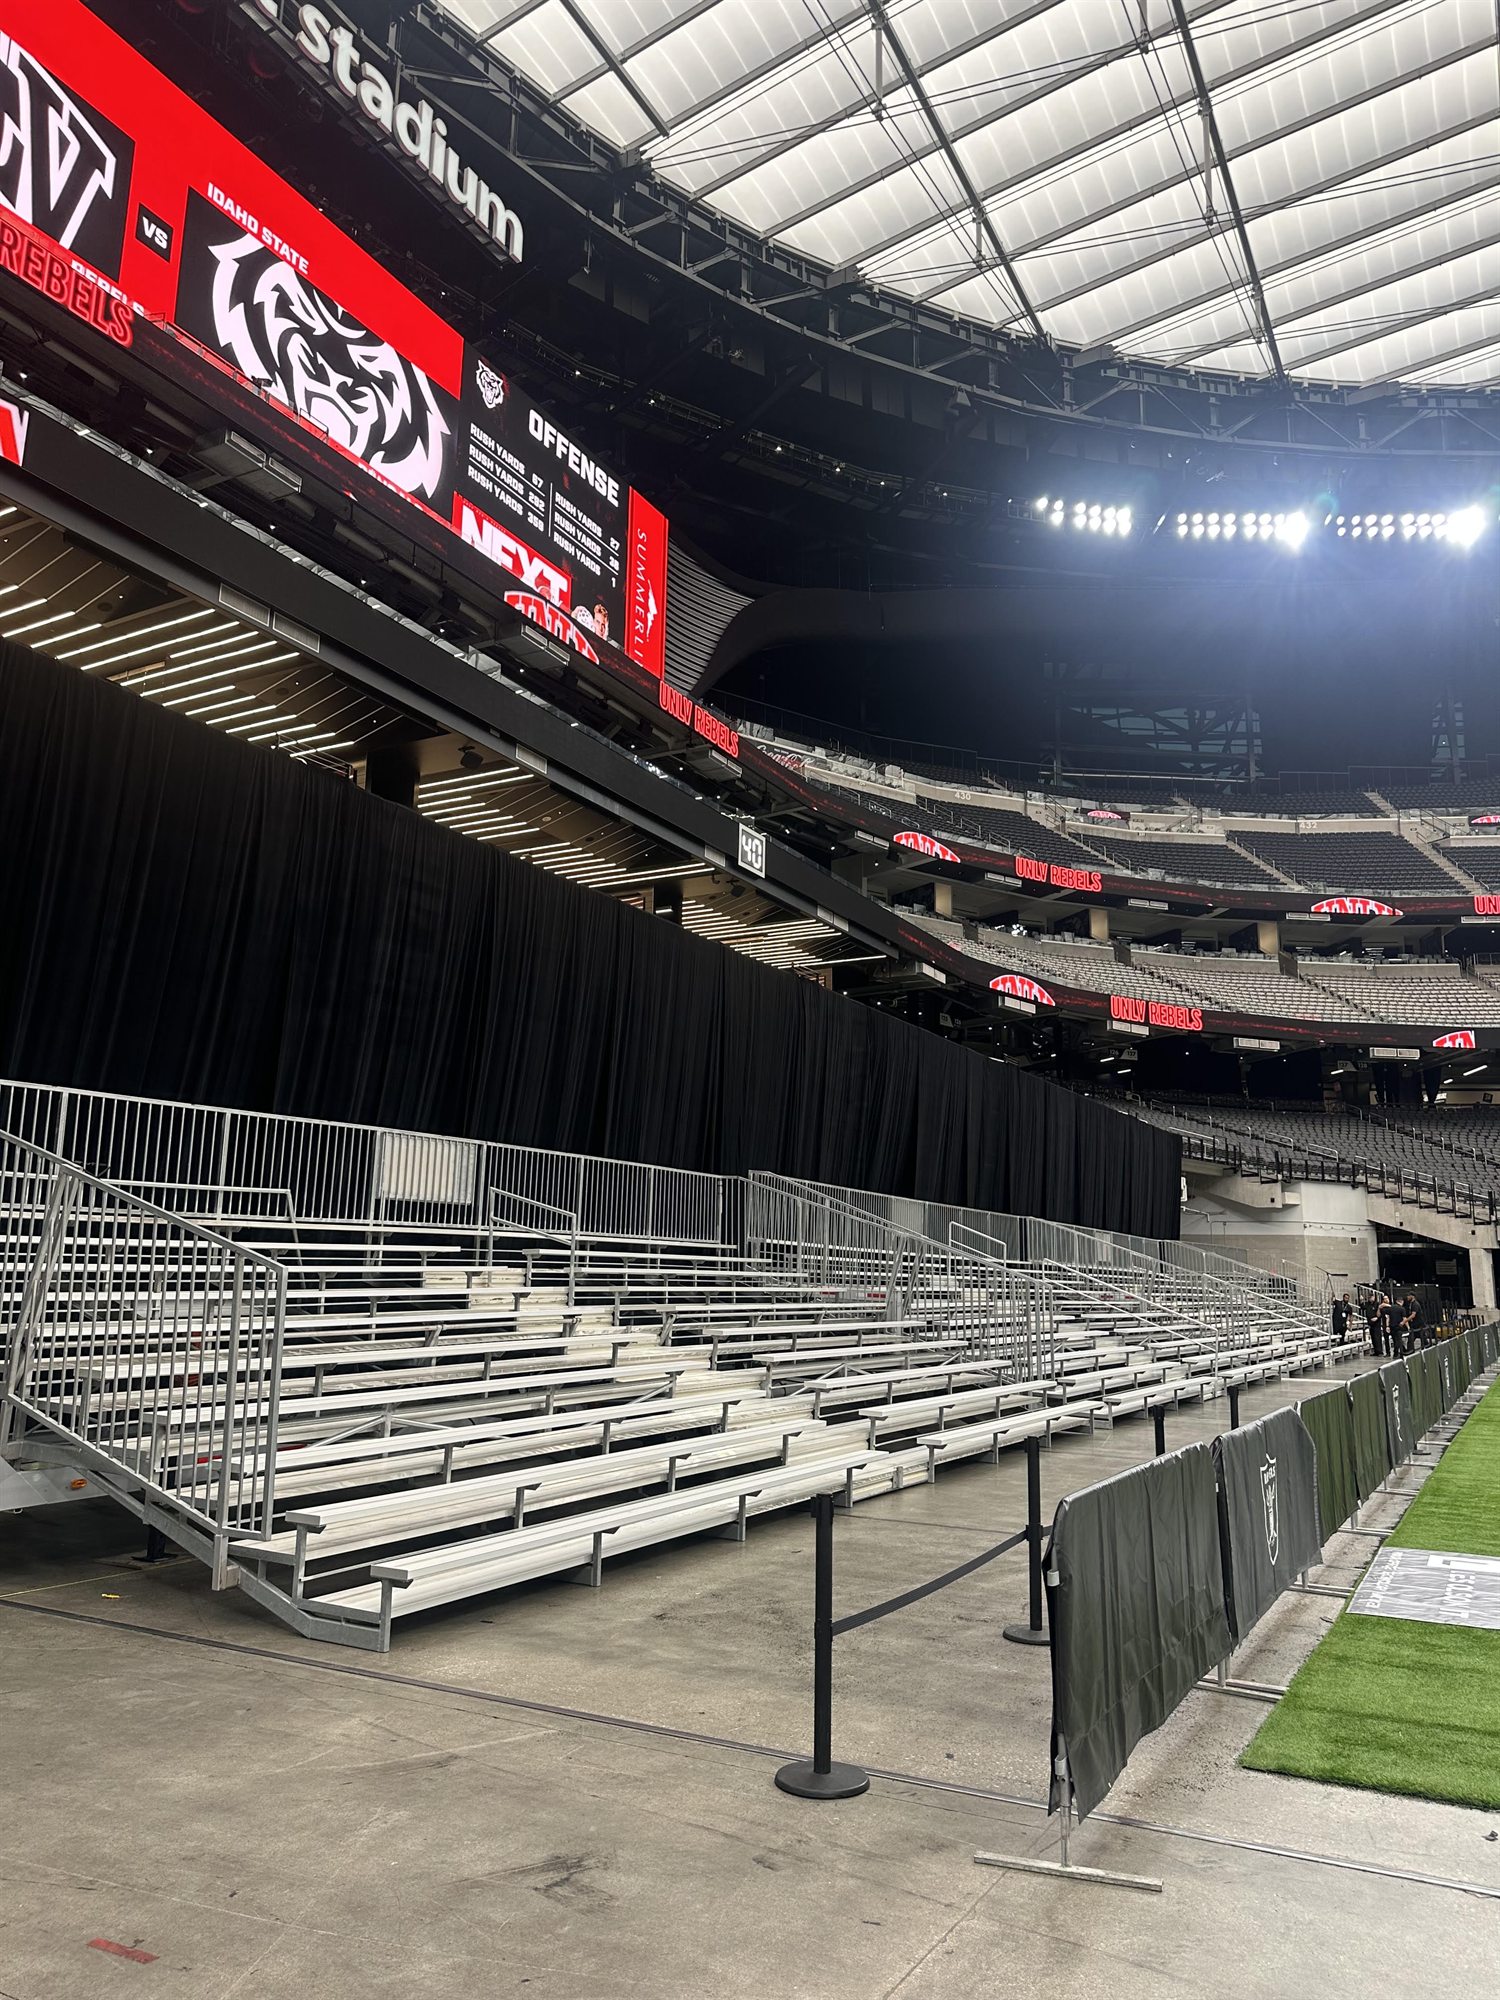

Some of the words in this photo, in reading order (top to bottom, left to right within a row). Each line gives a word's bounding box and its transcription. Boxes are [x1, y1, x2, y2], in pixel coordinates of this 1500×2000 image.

[295, 3, 524, 263] stadium
[142, 216, 168, 249] VS
[207, 181, 259, 234] IDAHO
[261, 226, 309, 275] STATE
[0, 219, 134, 349] REBELS
[469, 443, 494, 472] RUSH
[495, 463, 524, 495] YARDS
[470, 422, 496, 451] RUSH
[496, 442, 525, 475] YARDS
[528, 409, 620, 508] OFFENSE
[467, 464, 493, 493] RUSH
[494, 484, 523, 516] YARDS
[555, 491, 577, 517] RUSH
[577, 509, 602, 538] YARDS
[553, 531, 575, 556] RUSH
[575, 548, 601, 576] YARDS
[554, 511, 576, 537] RUSH
[576, 528, 602, 557] YARDS
[634, 528, 647, 667] SUMMERLI
[659, 679, 693, 726] UNLV
[694, 704, 739, 758] REBELS
[742, 834, 762, 869] 40
[1015, 856, 1048, 882] UNLV
[1050, 864, 1102, 892] REBELS
[1110, 995, 1146, 1023] UNLV
[1148, 1001, 1203, 1031] REBELS
